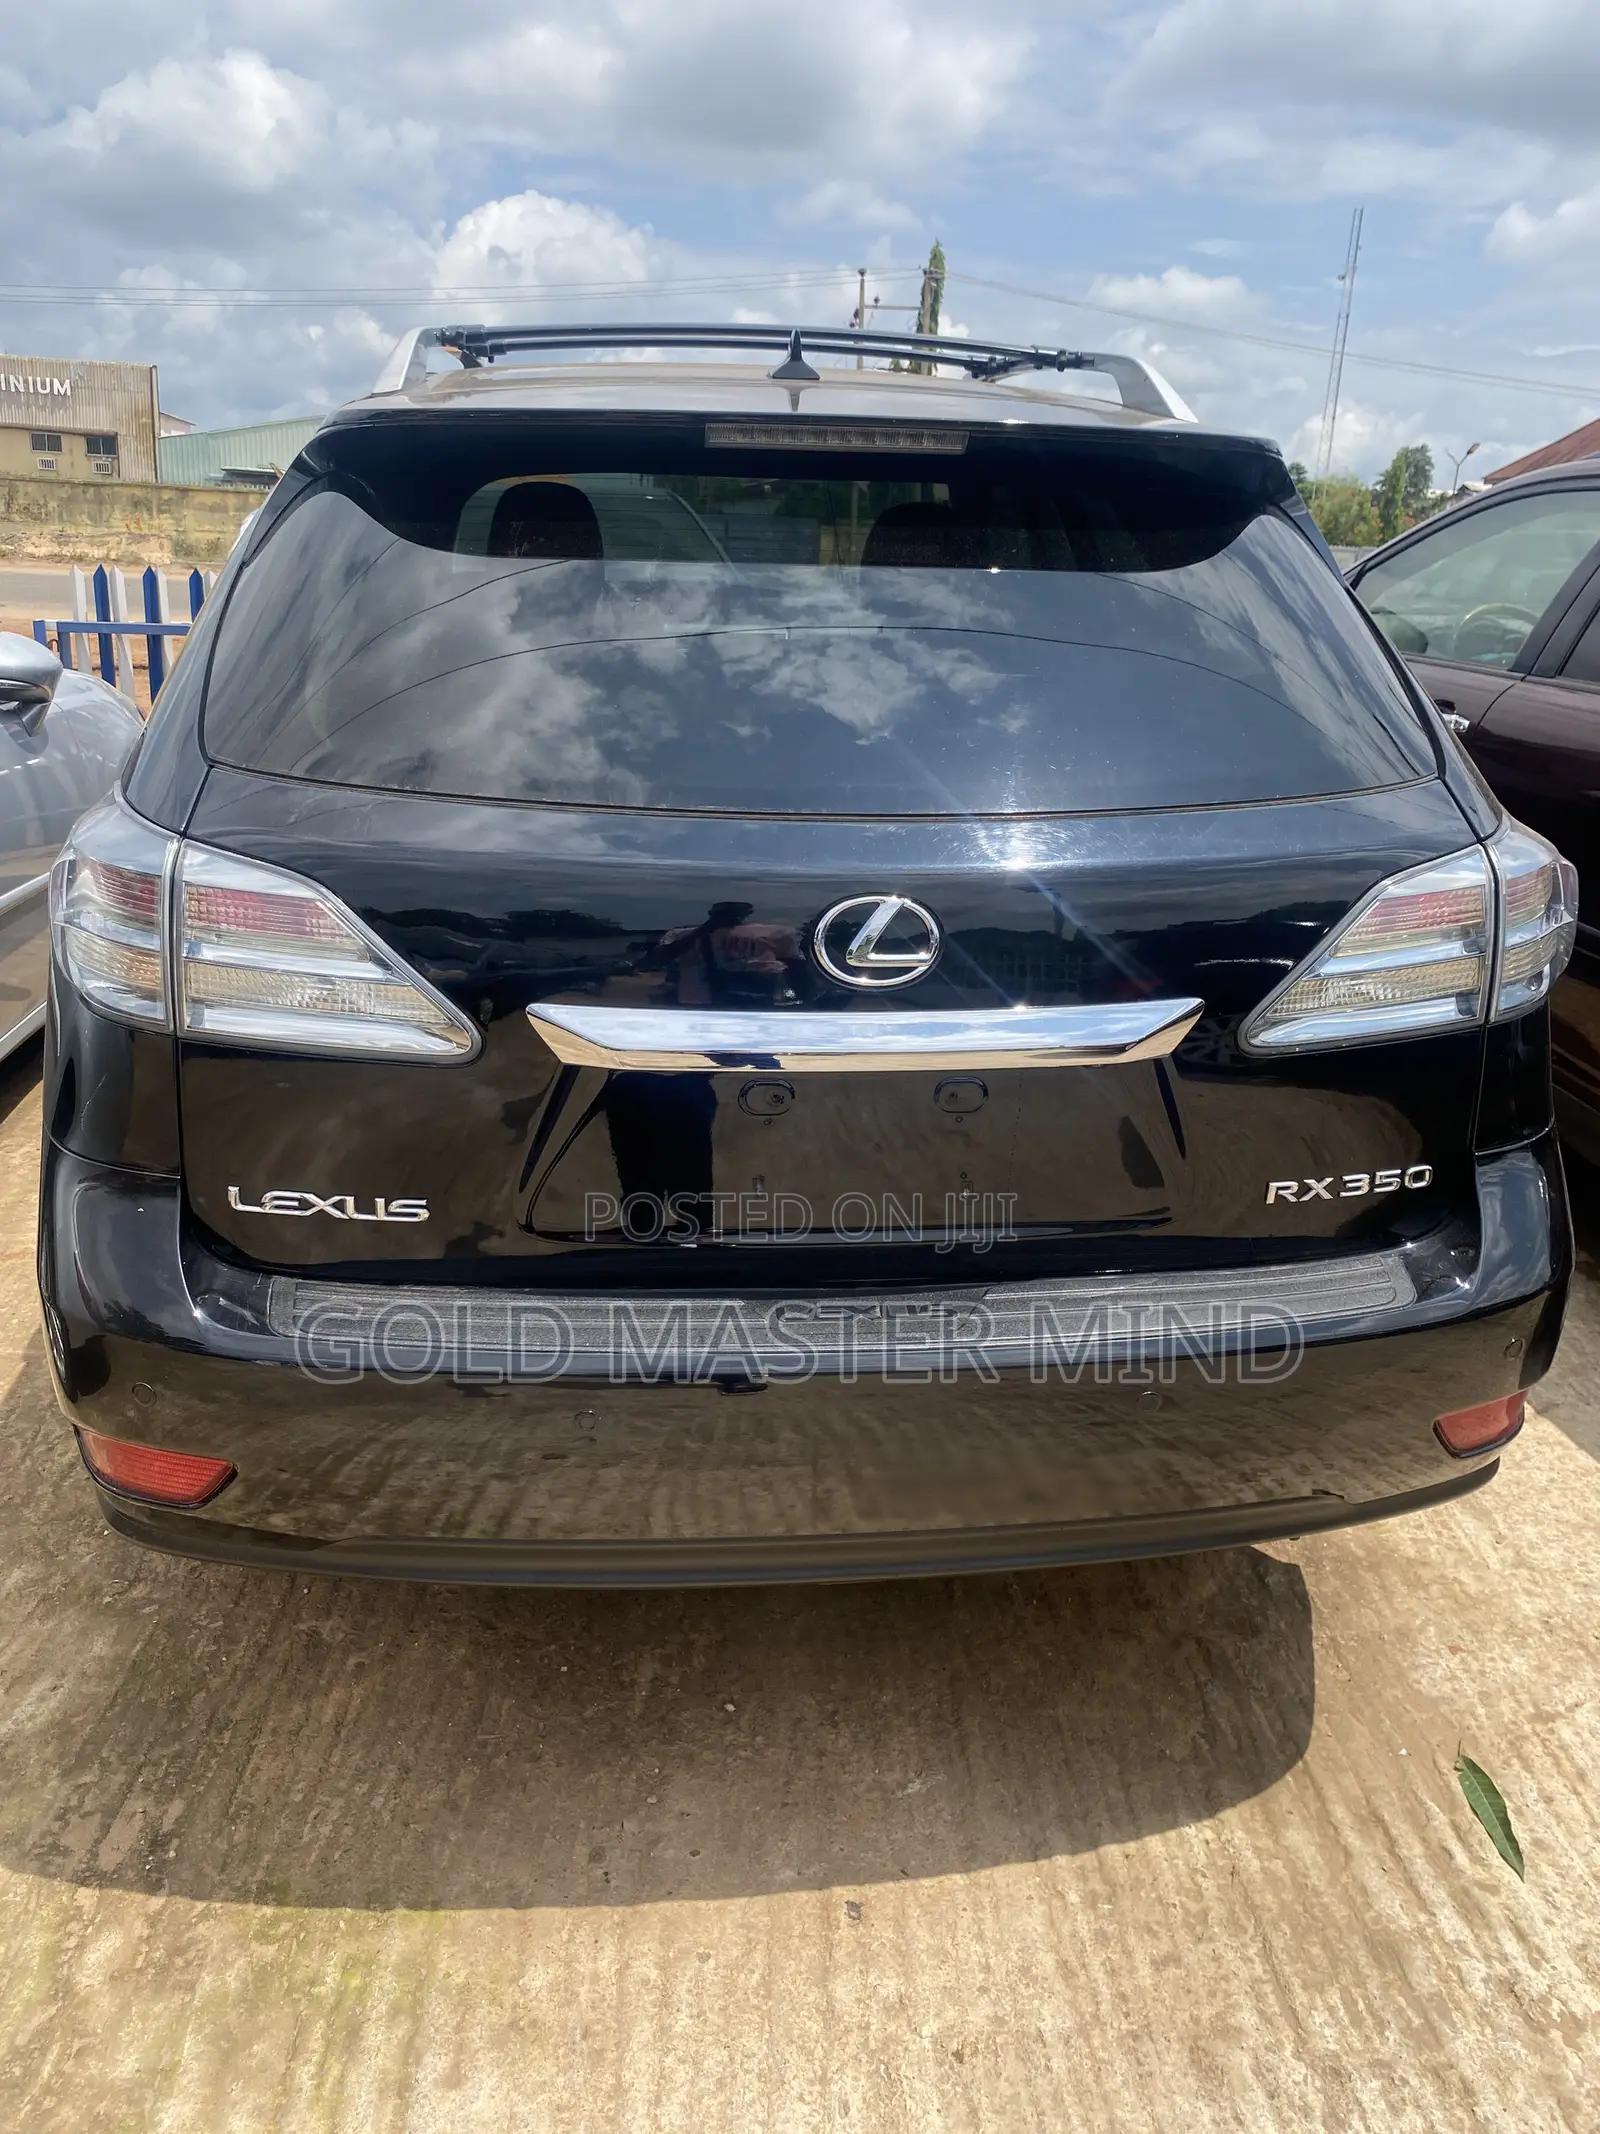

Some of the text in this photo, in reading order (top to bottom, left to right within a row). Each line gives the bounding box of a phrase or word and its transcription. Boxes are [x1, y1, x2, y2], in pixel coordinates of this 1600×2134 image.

[0, 373, 71, 396] INIUM
[1265, 1164, 1433, 1205] RX 350
[227, 1185, 431, 1223] LEXUS
